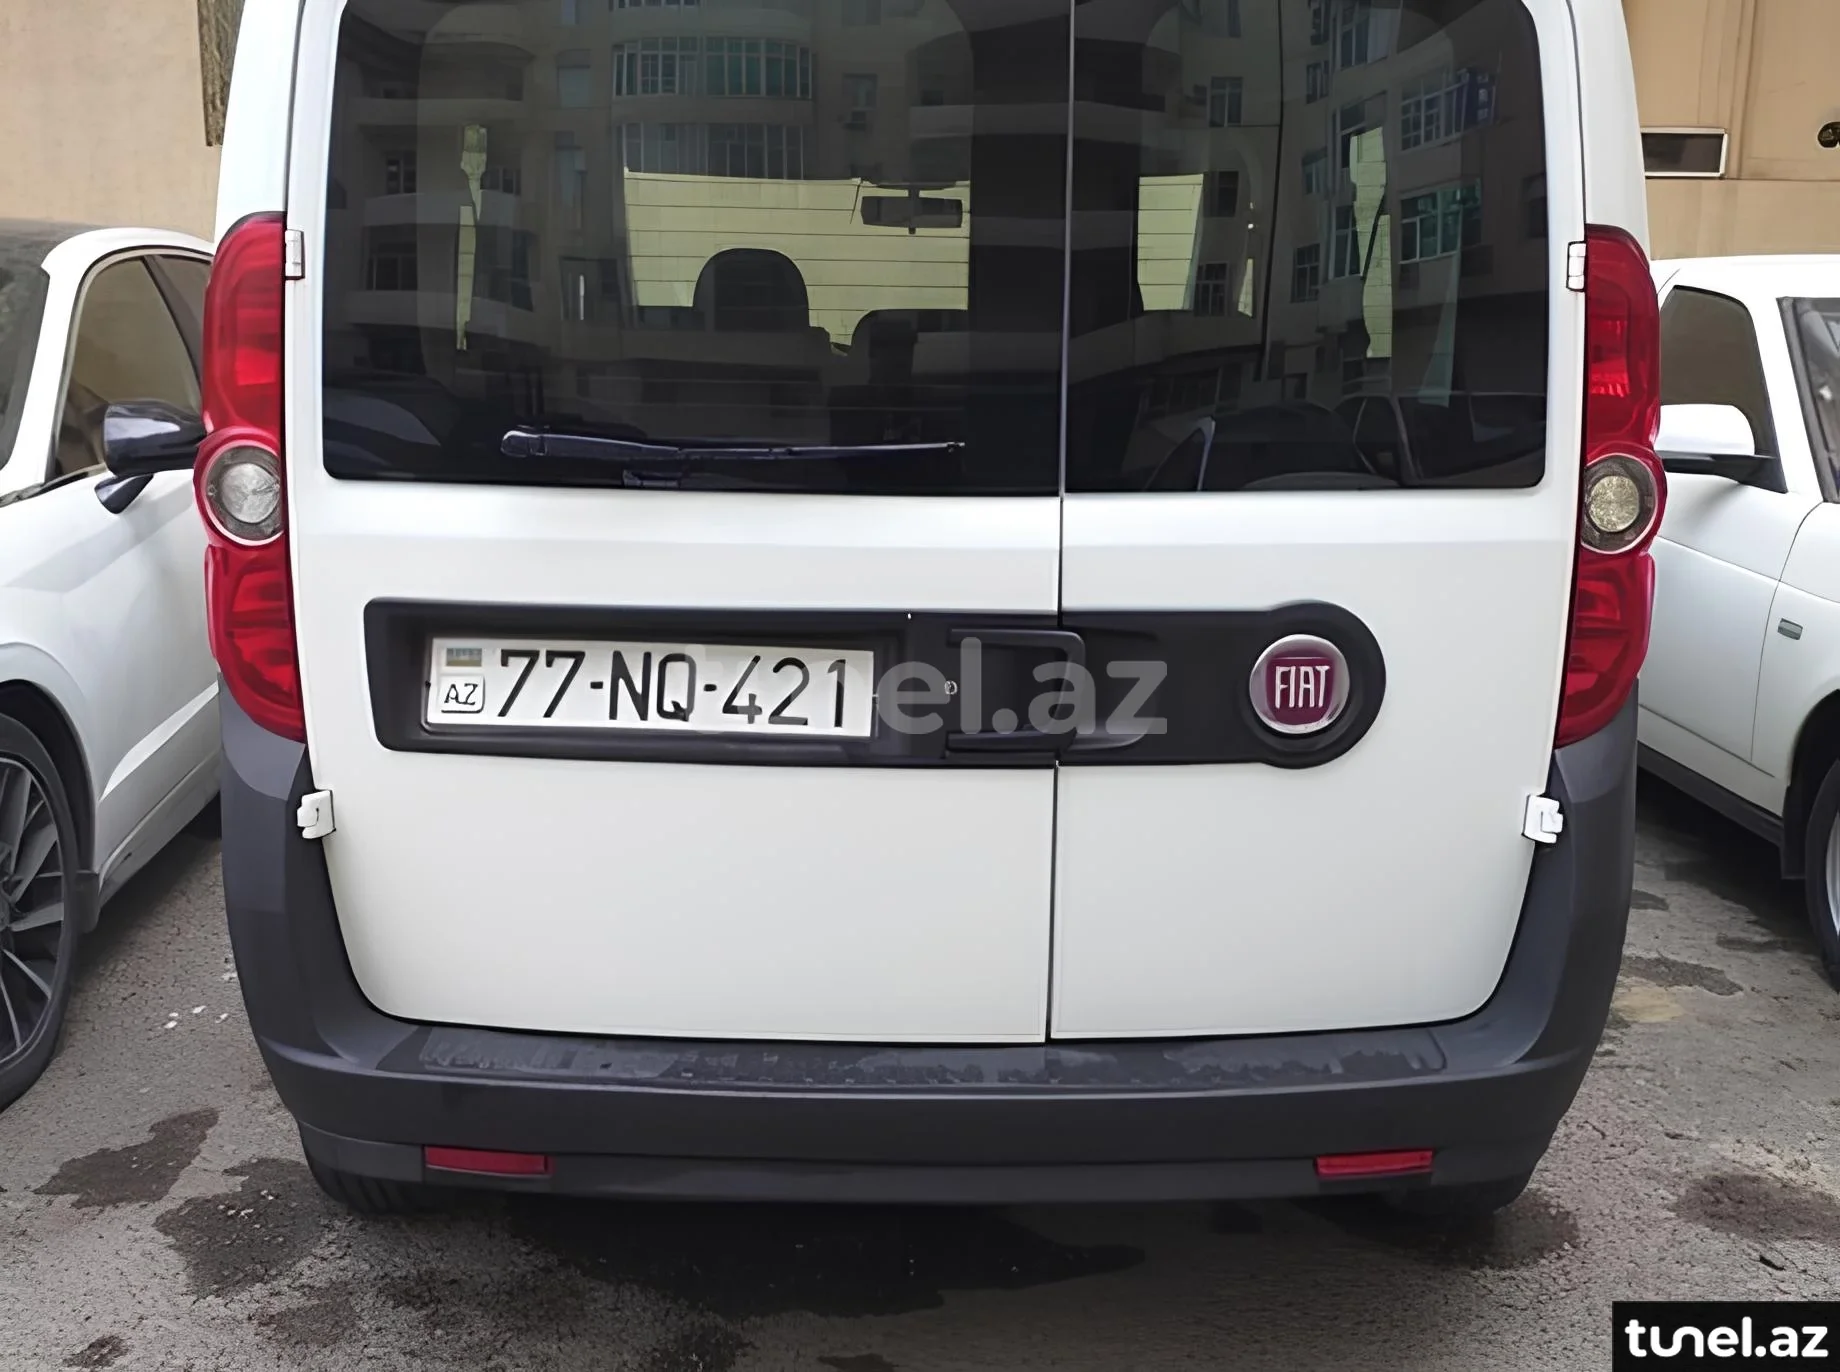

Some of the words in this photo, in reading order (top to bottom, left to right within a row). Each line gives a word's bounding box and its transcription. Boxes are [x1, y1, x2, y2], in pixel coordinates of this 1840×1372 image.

[443, 682, 481, 706] AZ
[497, 649, 846, 728] 77-NQ-421
[1273, 664, 1332, 709] FIAT
